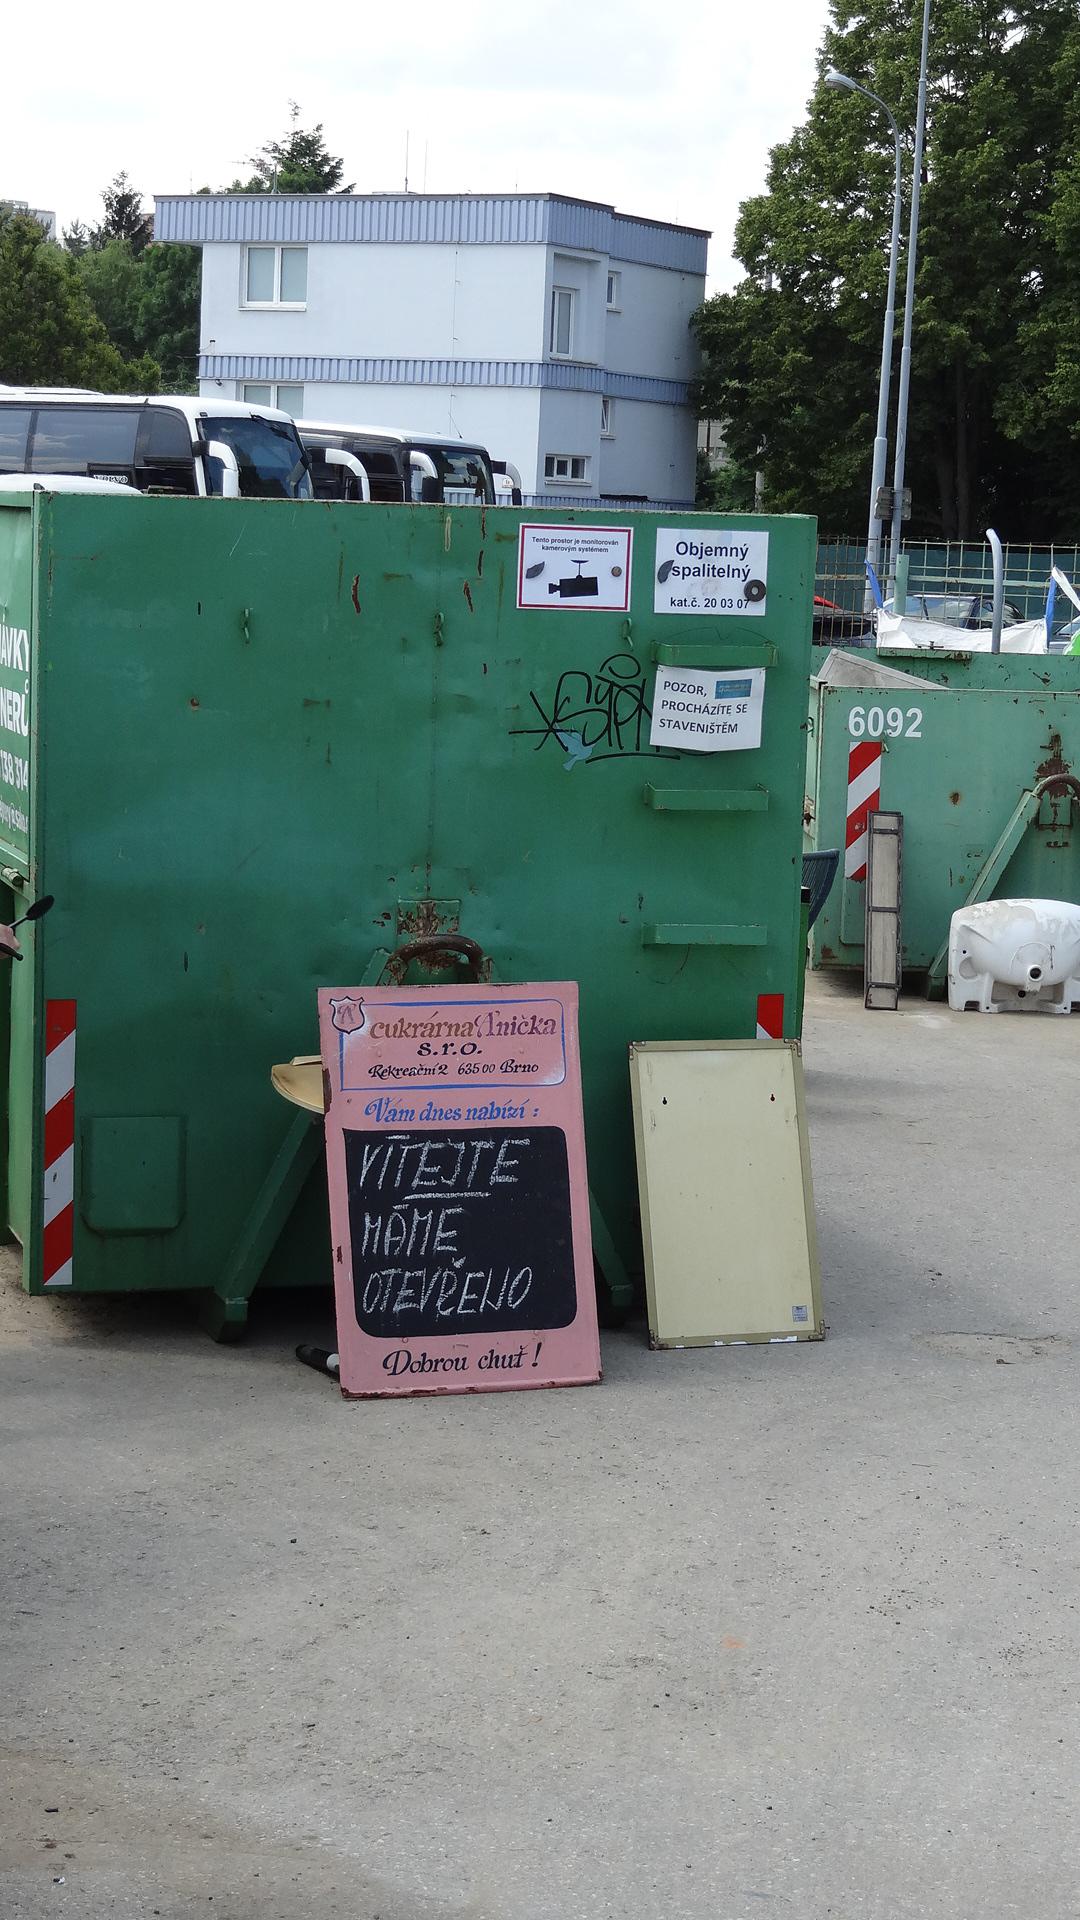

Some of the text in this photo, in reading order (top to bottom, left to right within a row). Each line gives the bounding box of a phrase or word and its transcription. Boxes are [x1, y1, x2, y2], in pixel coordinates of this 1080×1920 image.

[542, 545, 609, 553] kamerovým systémem
[551, 537, 573, 545] prostor
[574, 538, 580, 546] je
[581, 538, 619, 546] monitorován
[676, 541, 749, 561] Objemný
[672, 563, 751, 582] spalitelný
[670, 597, 750, 609] kat.č. 20 03 07
[664, 681, 707, 697] POZOR,
[661, 700, 748, 716] PROCHÁZÍTE SE
[659, 718, 738, 734] STAVENIŠTĚM
[848, 706, 923, 738] 6092
[370, 1010, 557, 1039] cukrárna Anička
[417, 1042, 482, 1056] s.r.o.
[368, 1063, 440, 1080] Rekreační
[500, 1059, 539, 1074] Brno
[365, 1097, 415, 1123] Vám
[419, 1101, 462, 1121] dnes
[362, 1204, 465, 1257] MÁME
[383, 1349, 469, 1376] Dobrou
